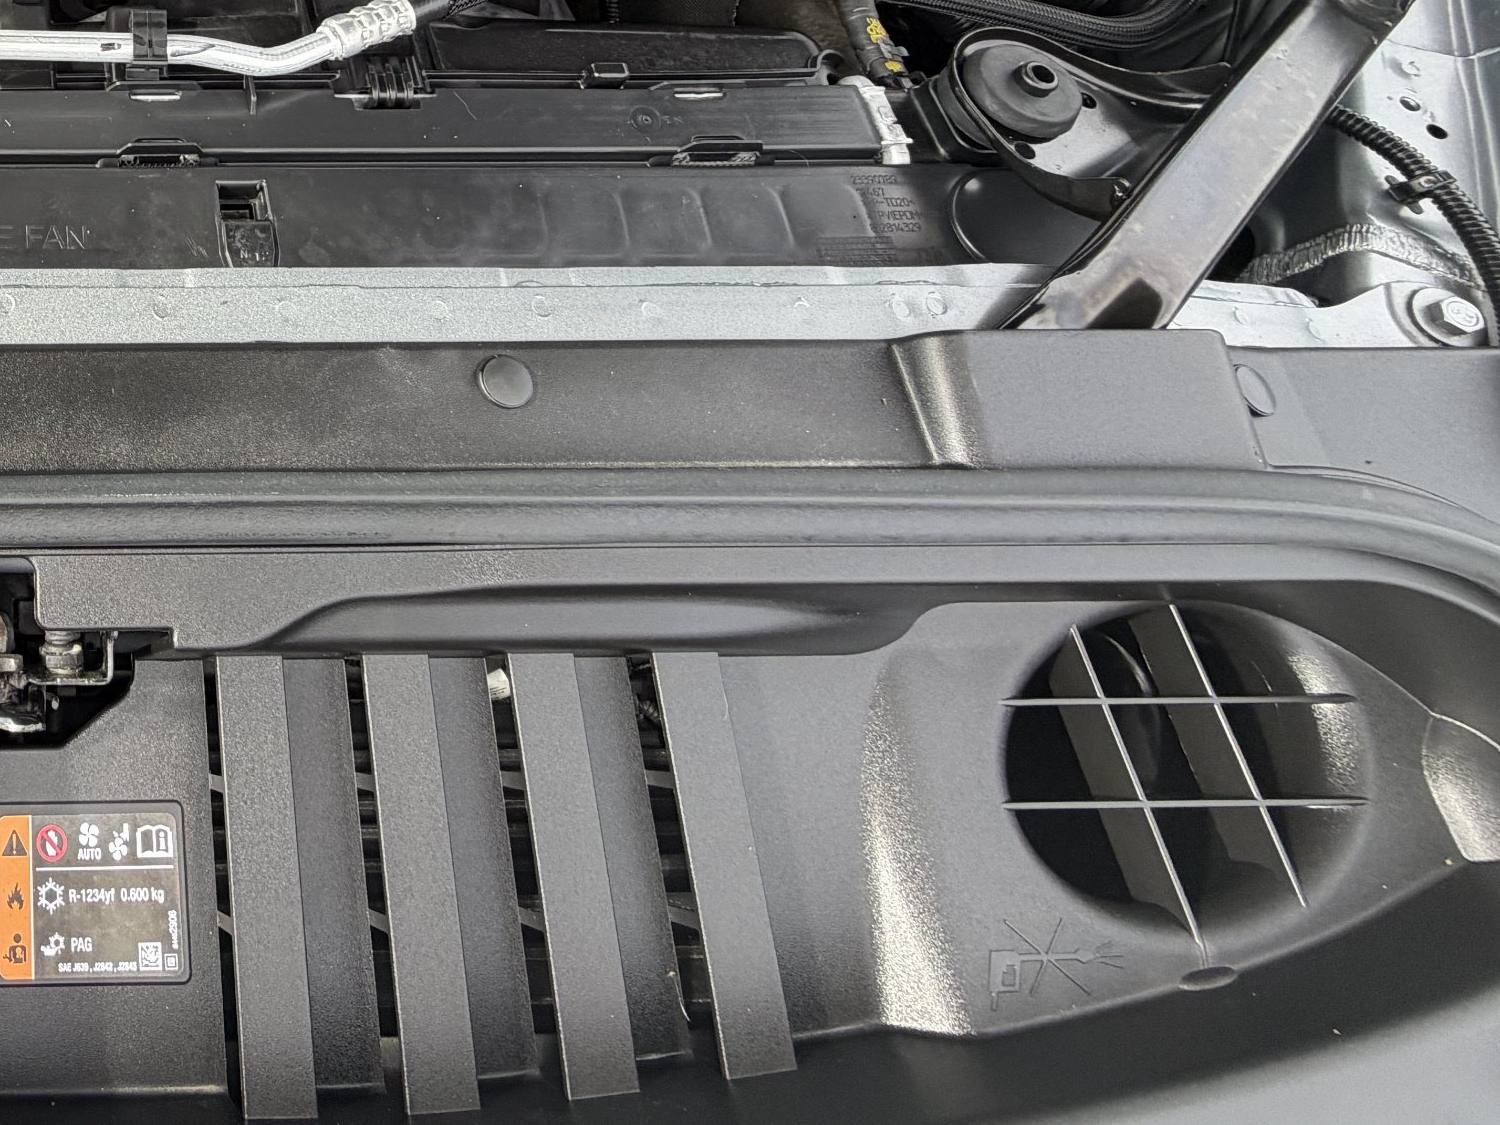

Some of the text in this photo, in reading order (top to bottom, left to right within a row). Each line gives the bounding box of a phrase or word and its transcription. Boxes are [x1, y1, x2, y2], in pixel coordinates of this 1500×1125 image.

[24, 224, 88, 250] FAN
[77, 847, 102, 860] AUTO
[68, 886, 165, 905] R-1234yf 0.600 kg
[70, 937, 93, 952] PAG
